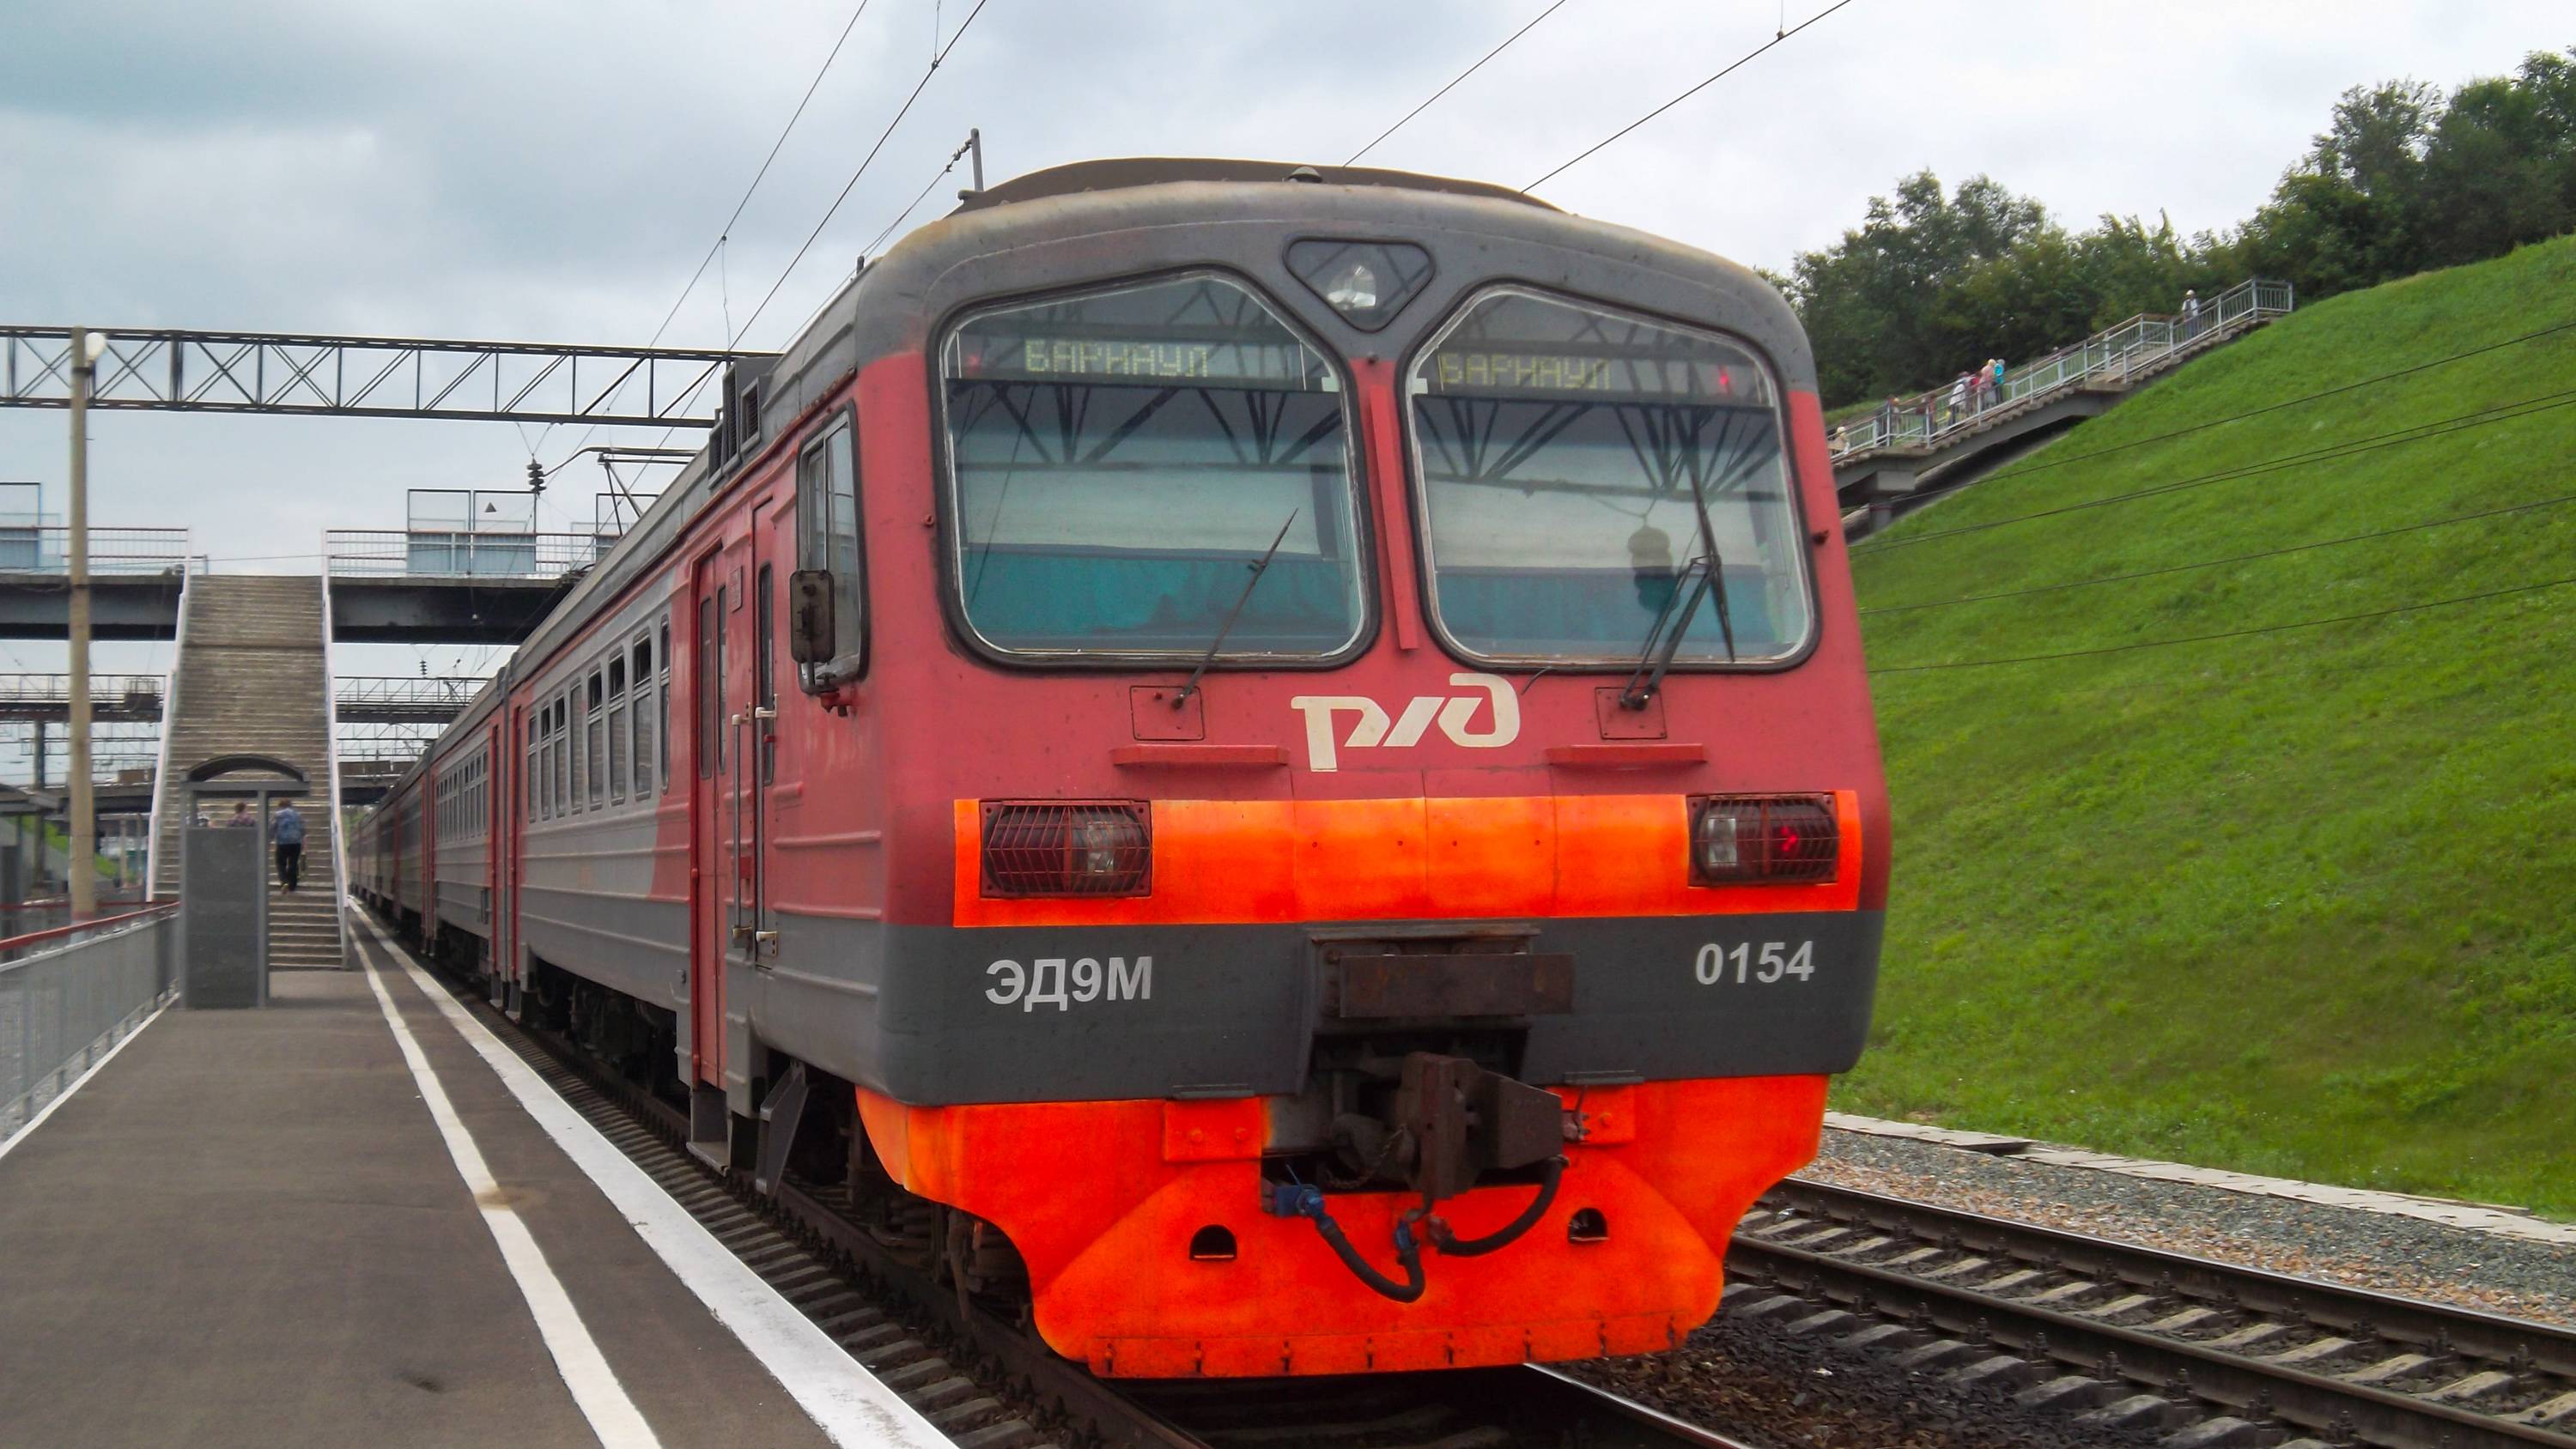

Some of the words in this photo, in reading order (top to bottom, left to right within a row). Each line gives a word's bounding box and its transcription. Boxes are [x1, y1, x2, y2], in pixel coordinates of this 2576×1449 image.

[1026, 339, 1208, 378] БАРНАУЛ
[1441, 353, 1610, 390] БАРНАУЛ
[1696, 940, 1814, 985] 0154
[985, 956, 1151, 1013] ЭД9М
